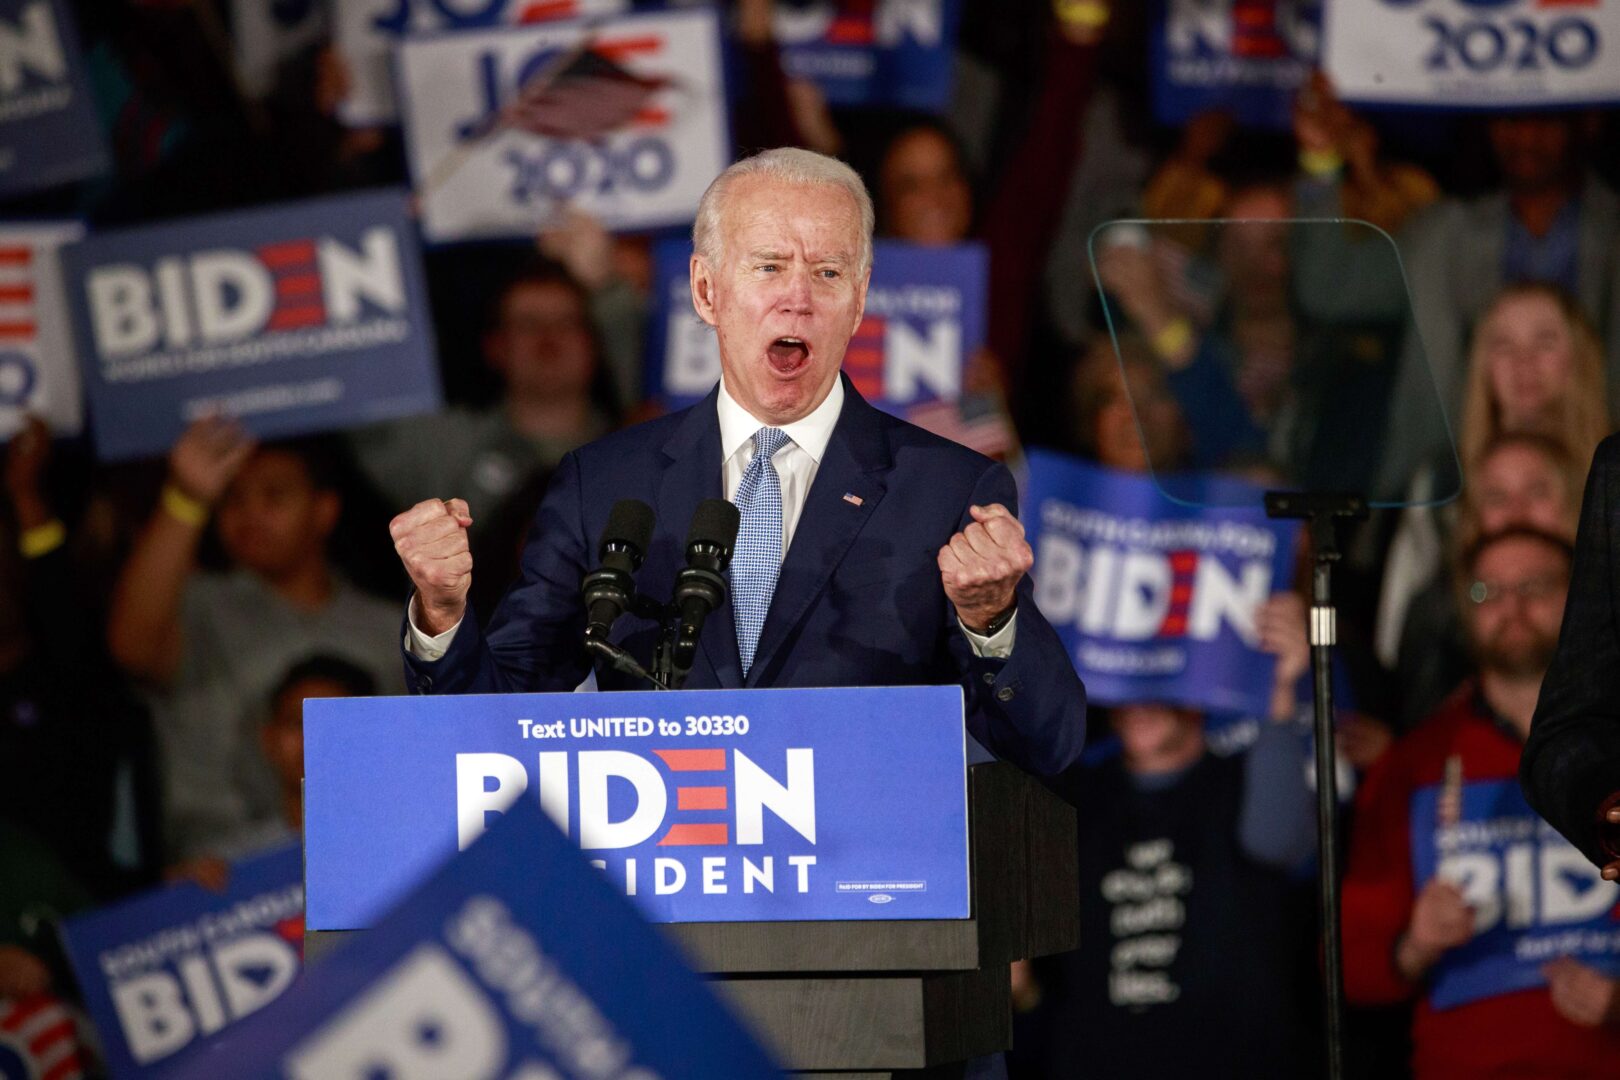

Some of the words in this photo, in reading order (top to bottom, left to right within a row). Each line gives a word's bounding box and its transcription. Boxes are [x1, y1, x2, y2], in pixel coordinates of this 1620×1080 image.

[1422, 17, 1598, 72] 2020
[505, 138, 676, 204] 2020
[87, 226, 405, 358] BIDEN
[1035, 532, 1272, 647] BIDEN
[518, 719, 565, 739] Text
[570, 717, 654, 738] UNITED
[658, 718, 682, 736] to
[685, 715, 750, 736] 30330
[456, 748, 816, 852] BIDEN
[592, 855, 817, 895] IDENT
[1438, 839, 1620, 934] BID
[112, 932, 303, 1066] BID
